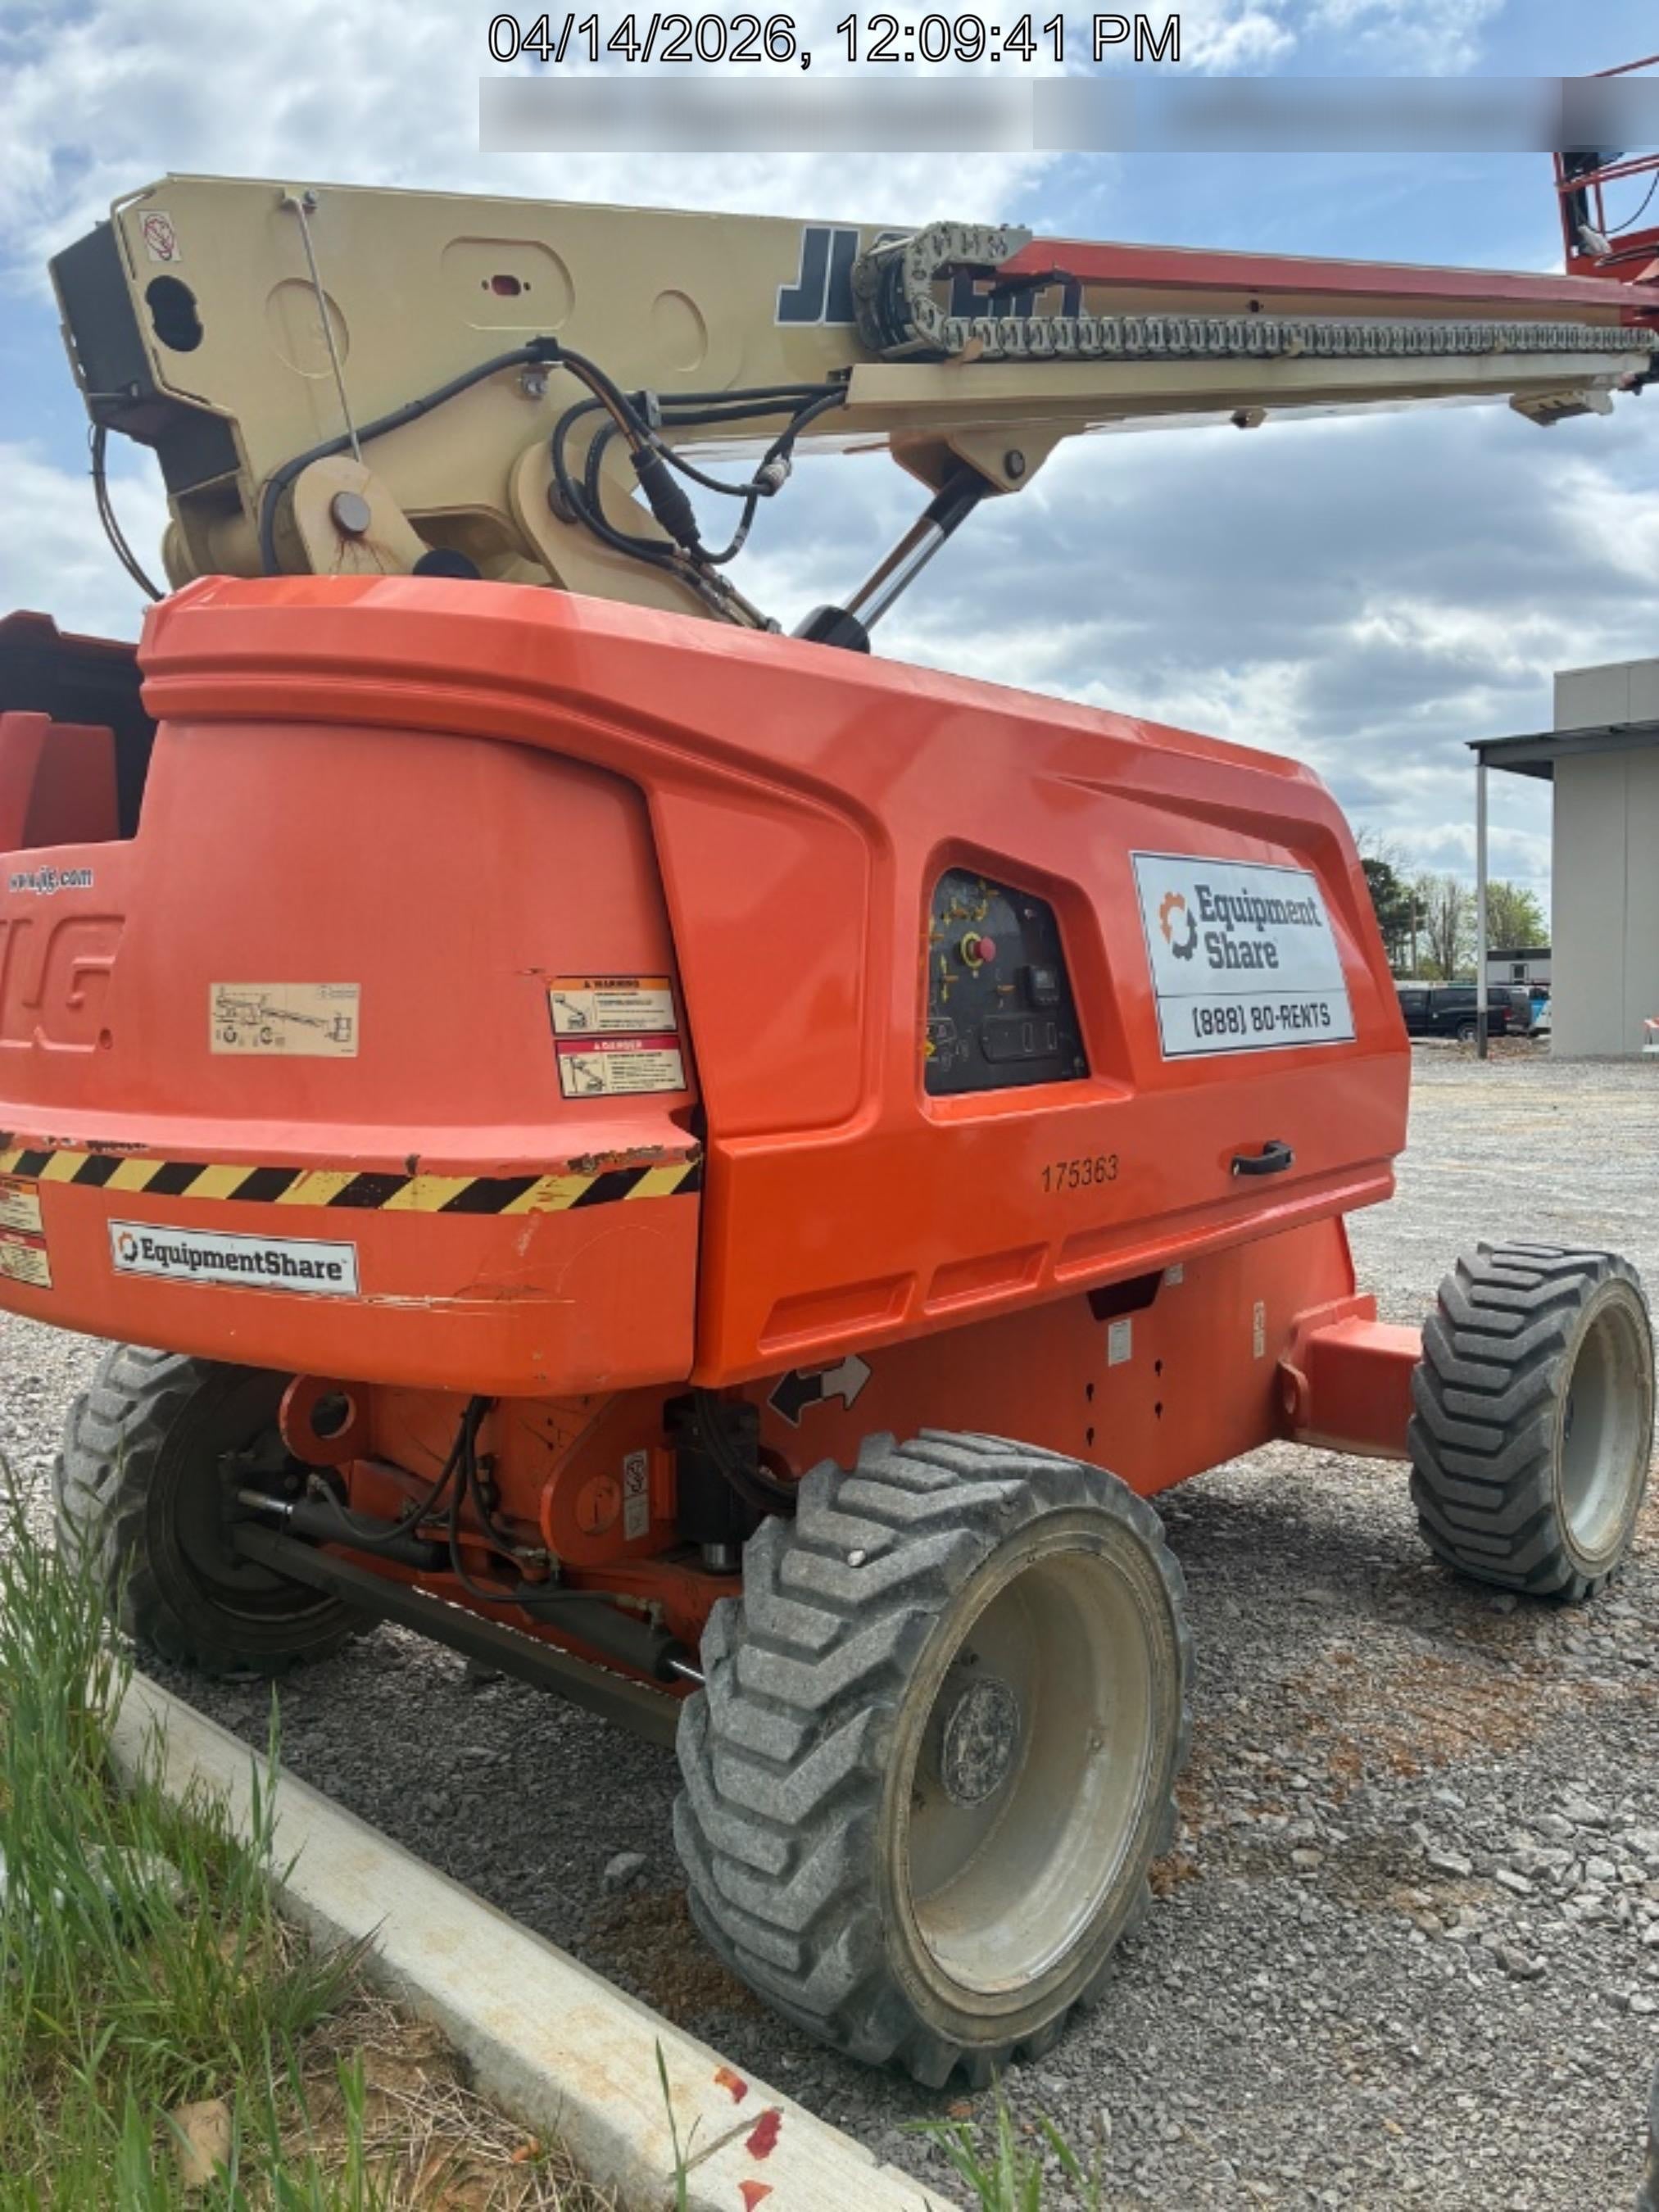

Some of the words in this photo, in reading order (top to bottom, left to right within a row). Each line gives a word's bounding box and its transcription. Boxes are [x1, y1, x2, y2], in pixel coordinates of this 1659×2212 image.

[1194, 884, 1322, 932] Equipment
[1203, 931, 1280, 969] Share
[1192, 1004, 1245, 1038] (888)
[1250, 1002, 1331, 1031] 80-RENTS
[1041, 1154, 1119, 1193] 175363
[140, 1237, 342, 1281] EquipmentShare
